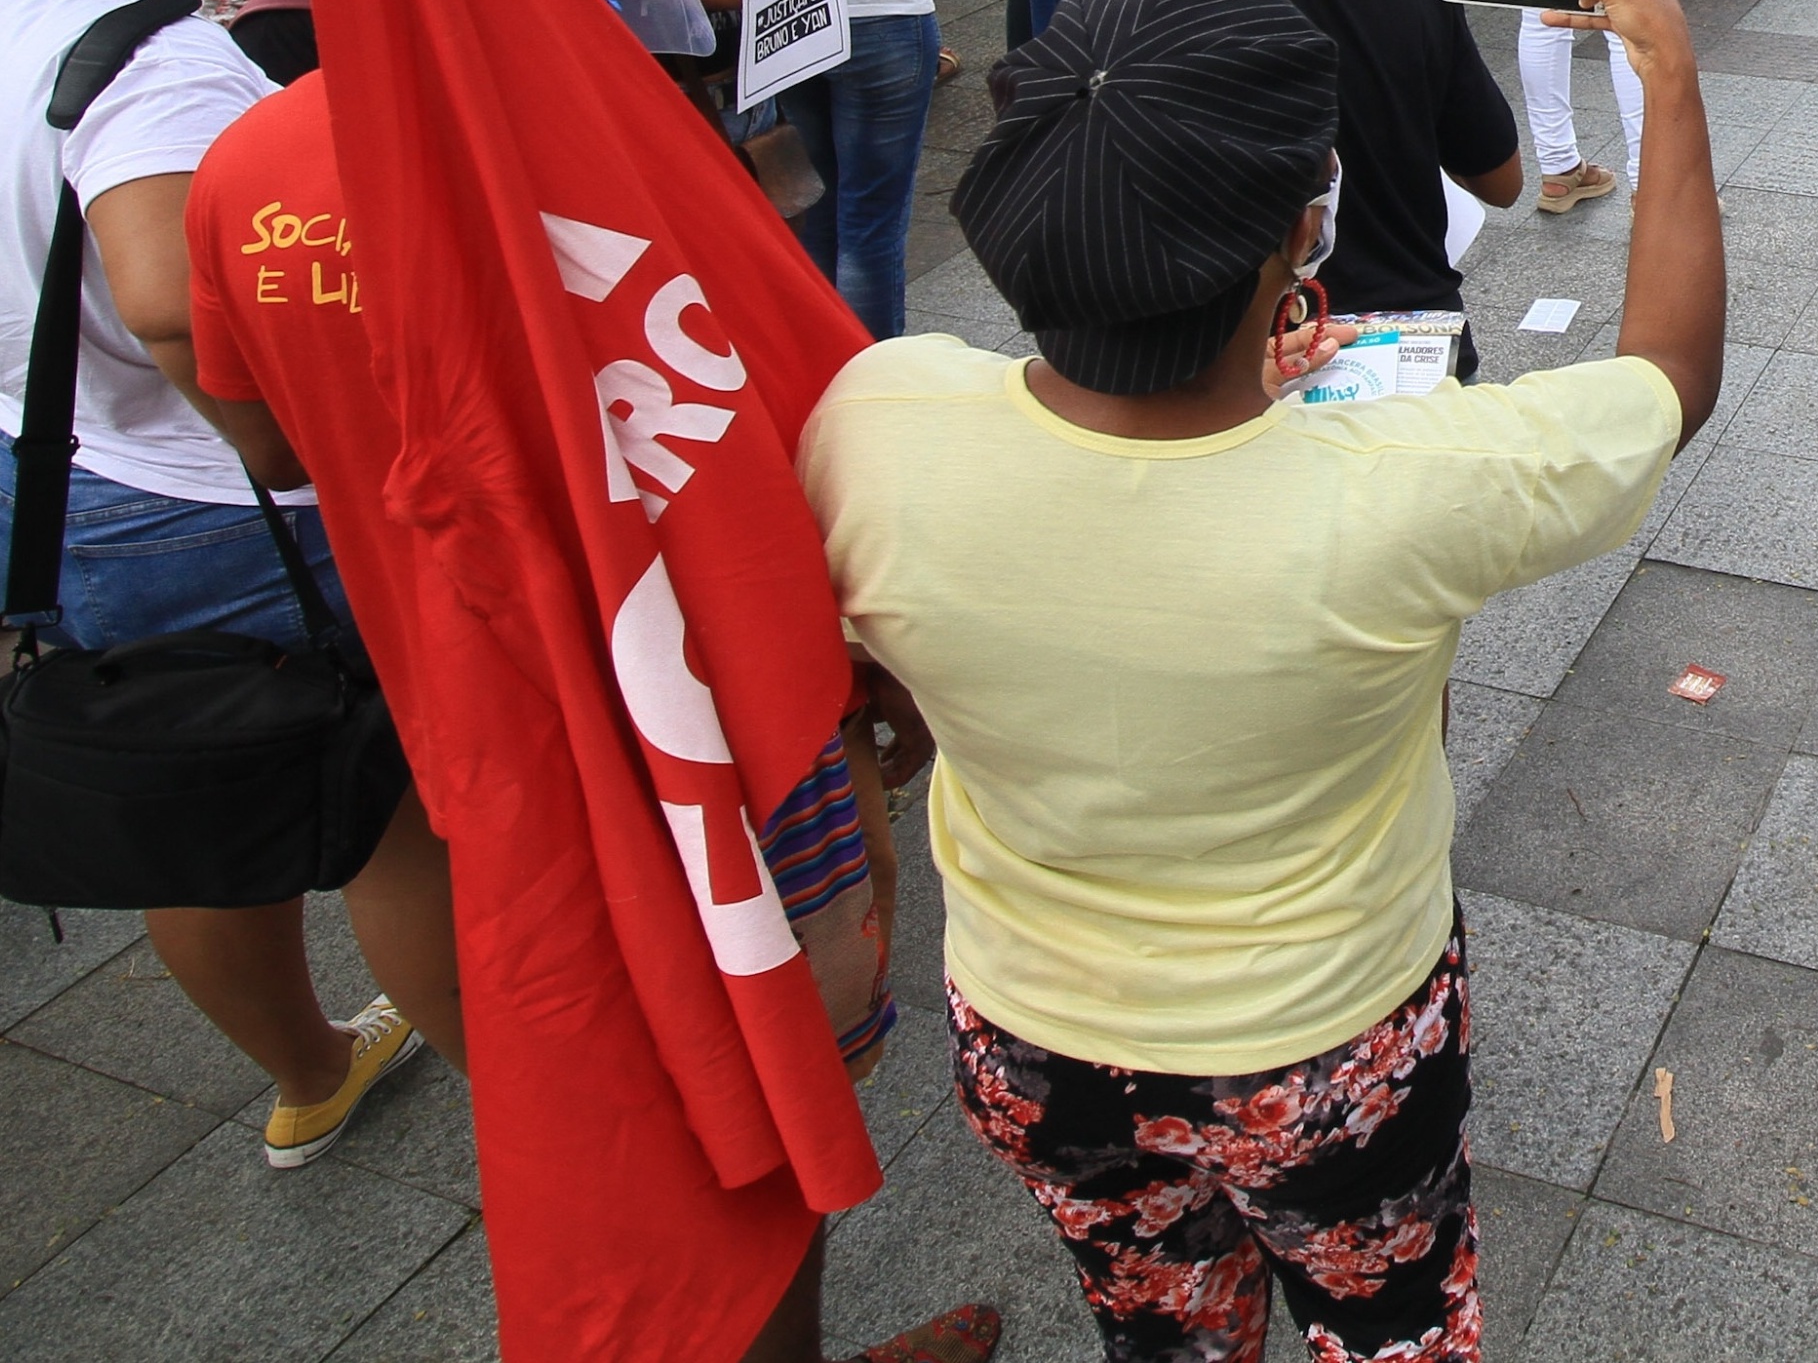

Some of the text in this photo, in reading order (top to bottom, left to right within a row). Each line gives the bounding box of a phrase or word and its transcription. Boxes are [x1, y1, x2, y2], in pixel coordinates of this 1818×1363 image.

[756, 11, 829, 61] BRUNO E YAN
[256, 264, 289, 304] E
[1413, 354, 1440, 364] CRISE
